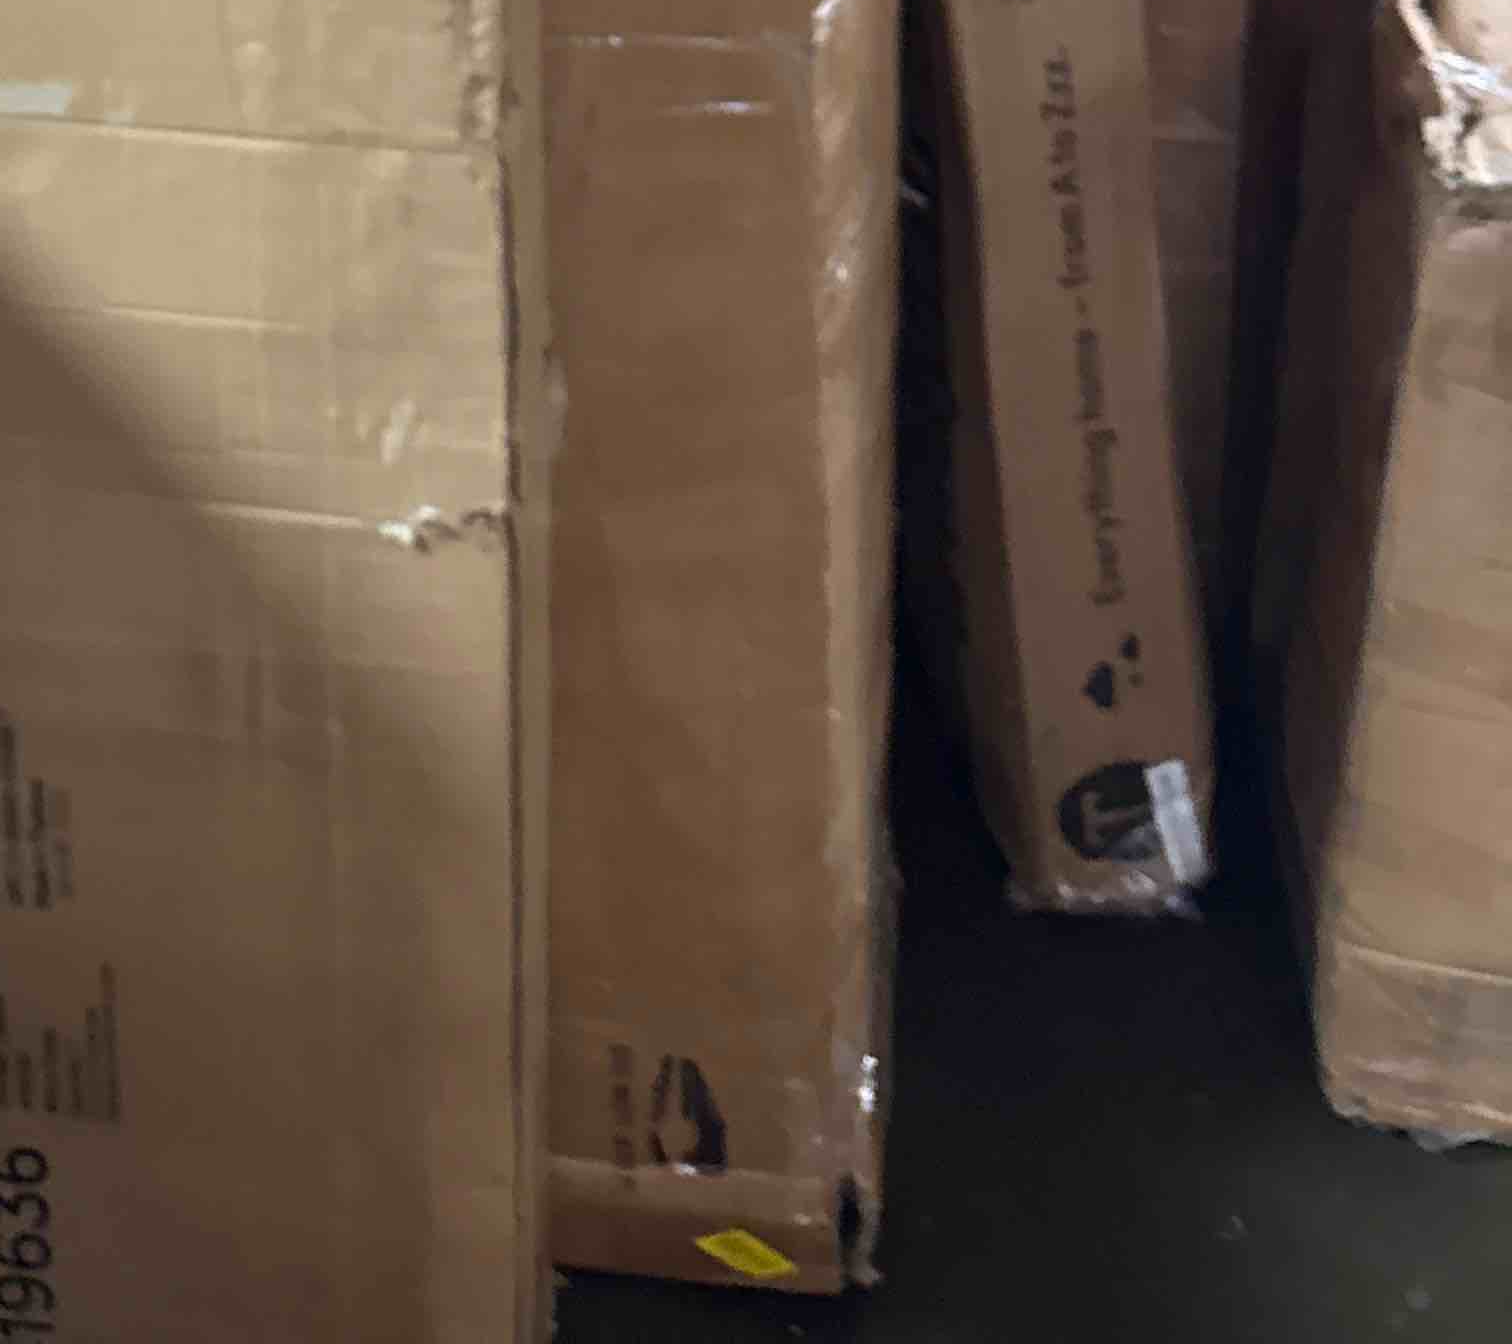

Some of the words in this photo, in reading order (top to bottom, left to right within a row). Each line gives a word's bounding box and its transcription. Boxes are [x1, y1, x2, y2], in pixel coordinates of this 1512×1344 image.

[1042, 129, 1078, 165] to
[1047, 171, 1080, 196] A
[1056, 202, 1092, 289] from
[1073, 328, 1104, 422] home
[1087, 426, 1127, 607] Everything
